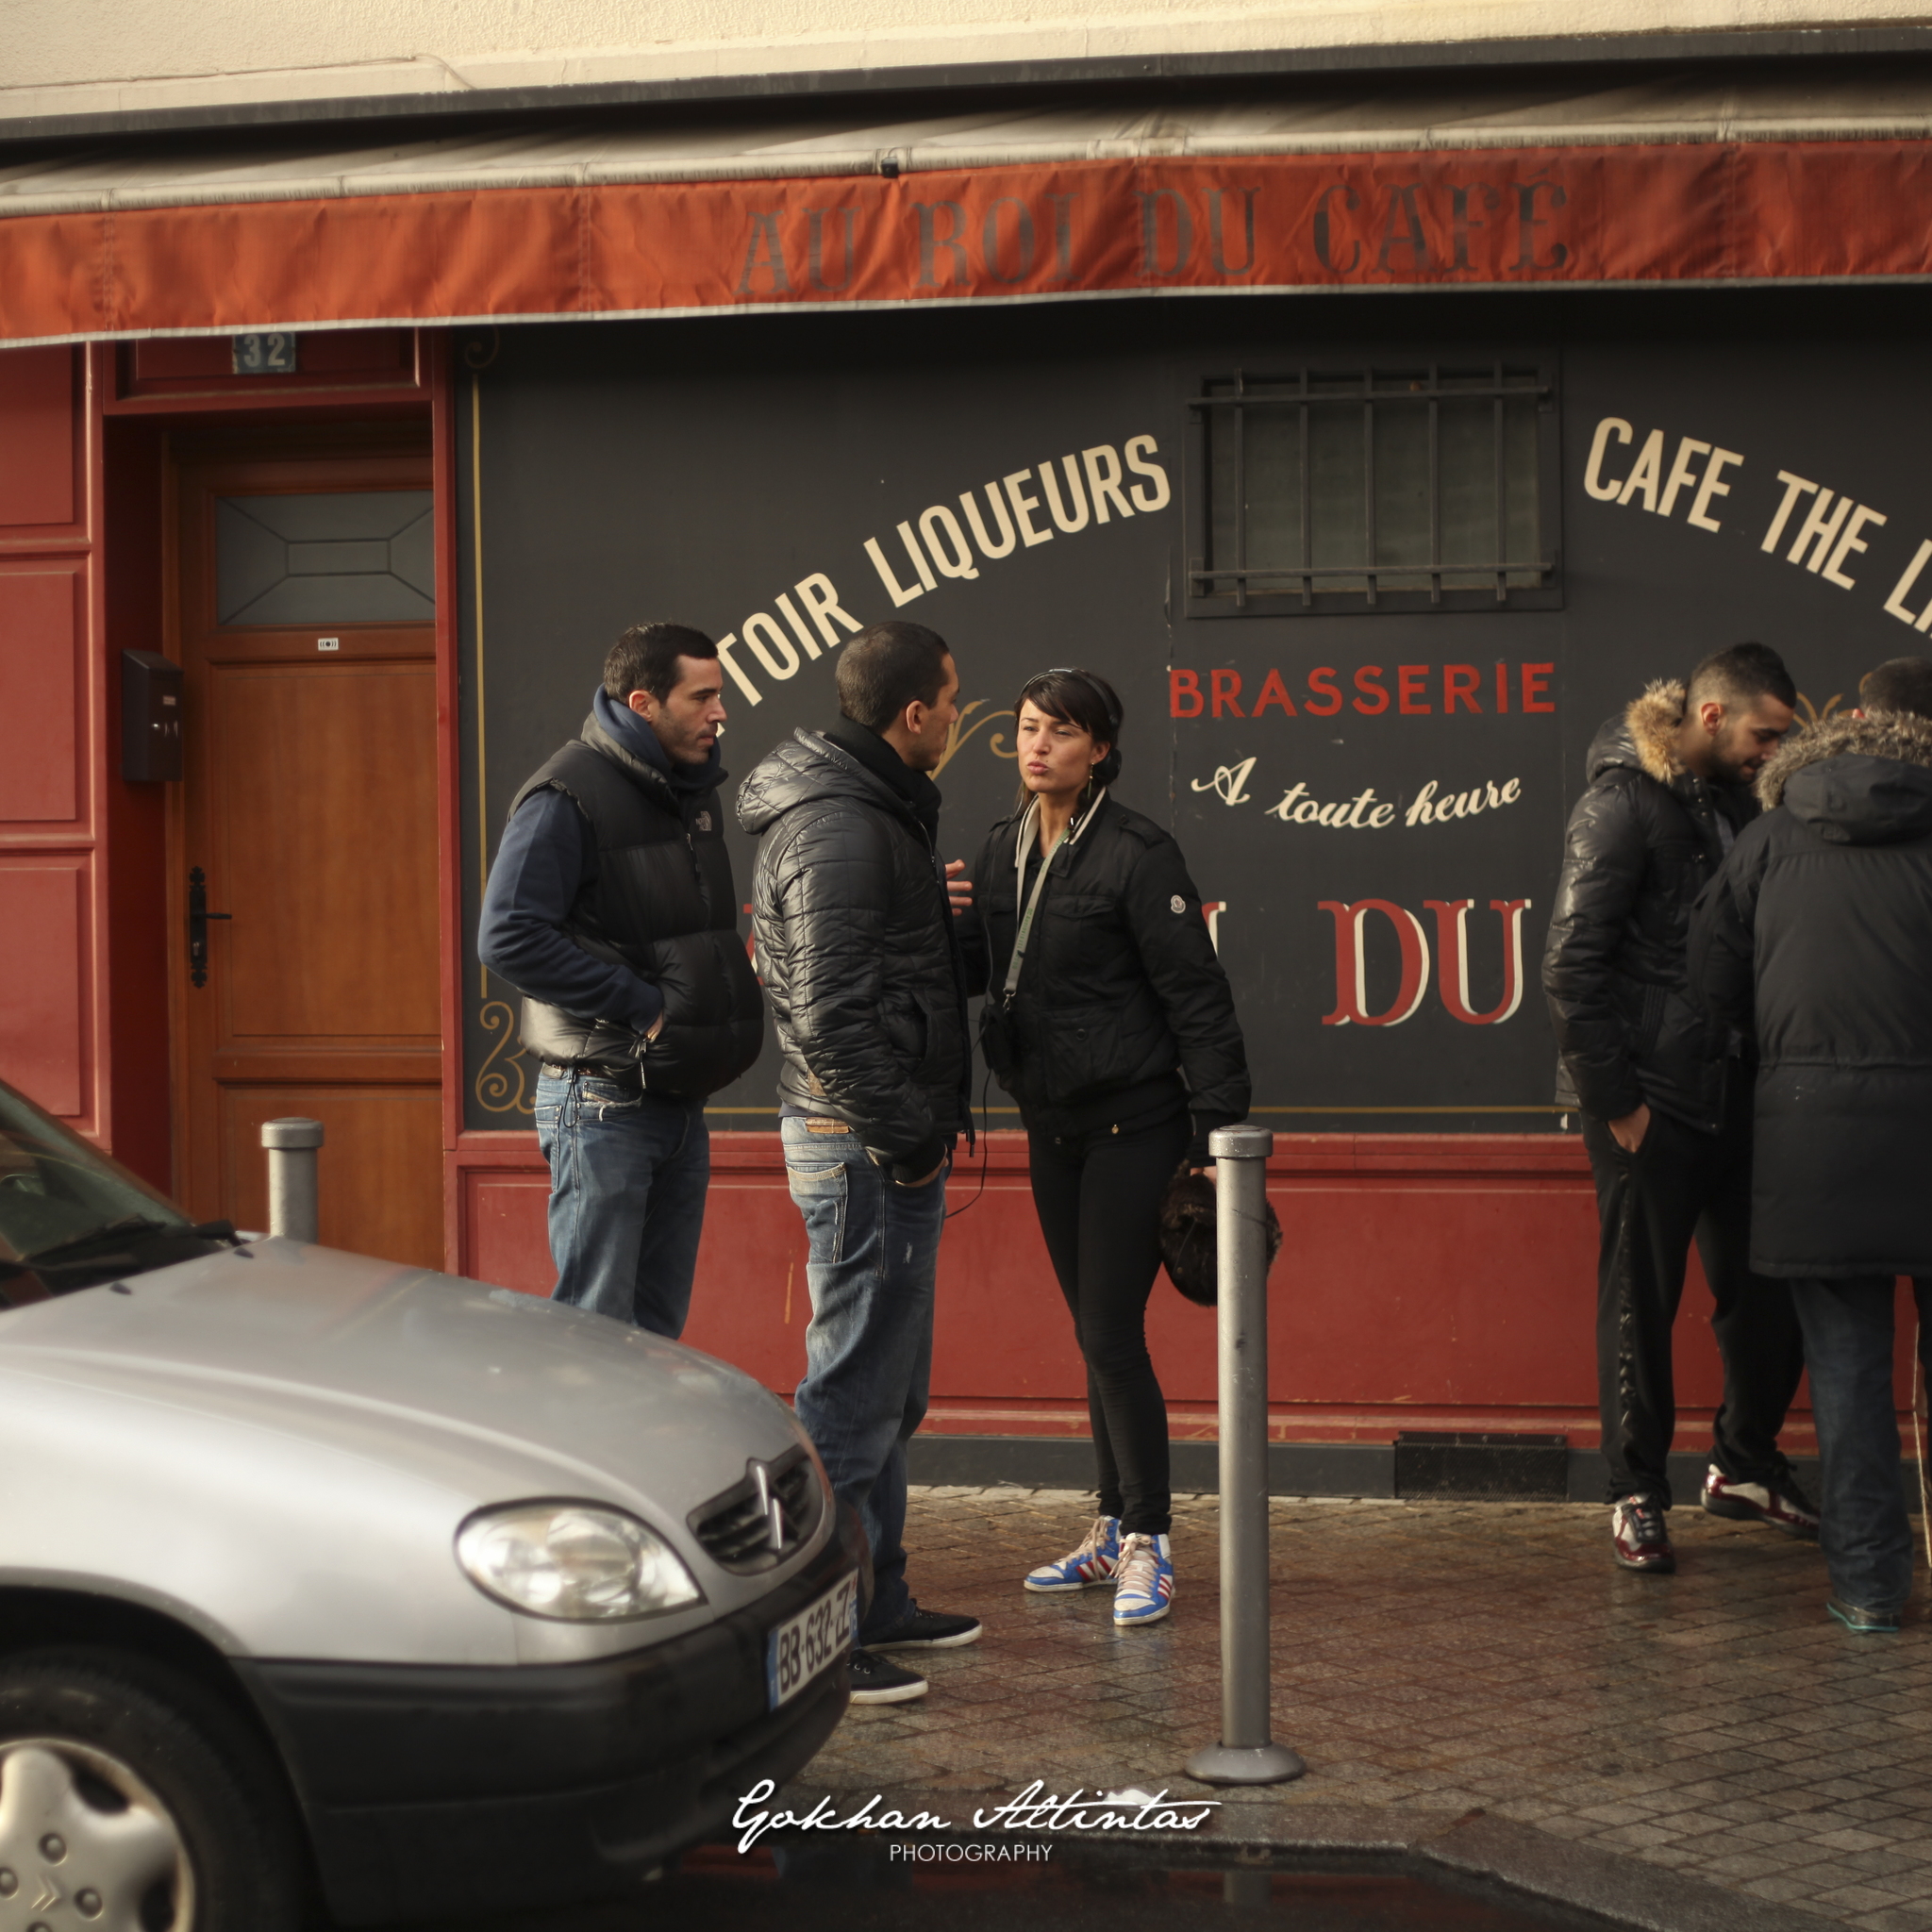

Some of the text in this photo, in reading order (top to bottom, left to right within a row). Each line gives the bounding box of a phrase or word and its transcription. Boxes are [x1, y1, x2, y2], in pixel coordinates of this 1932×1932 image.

[732, 206, 861, 294] AU
[909, 192, 1081, 289] ROI
[1132, 187, 1261, 277] DU
[243, 333, 286, 367] 32
[1584, 417, 1744, 533] CAFE
[1760, 470, 1888, 591] THE
[716, 434, 1171, 737] TOIR LIQUEURS
[1169, 662, 1556, 718] BRASSERIE
[1191, 757, 1522, 828] A toute heure
[1317, 898, 1532, 1026] DU
